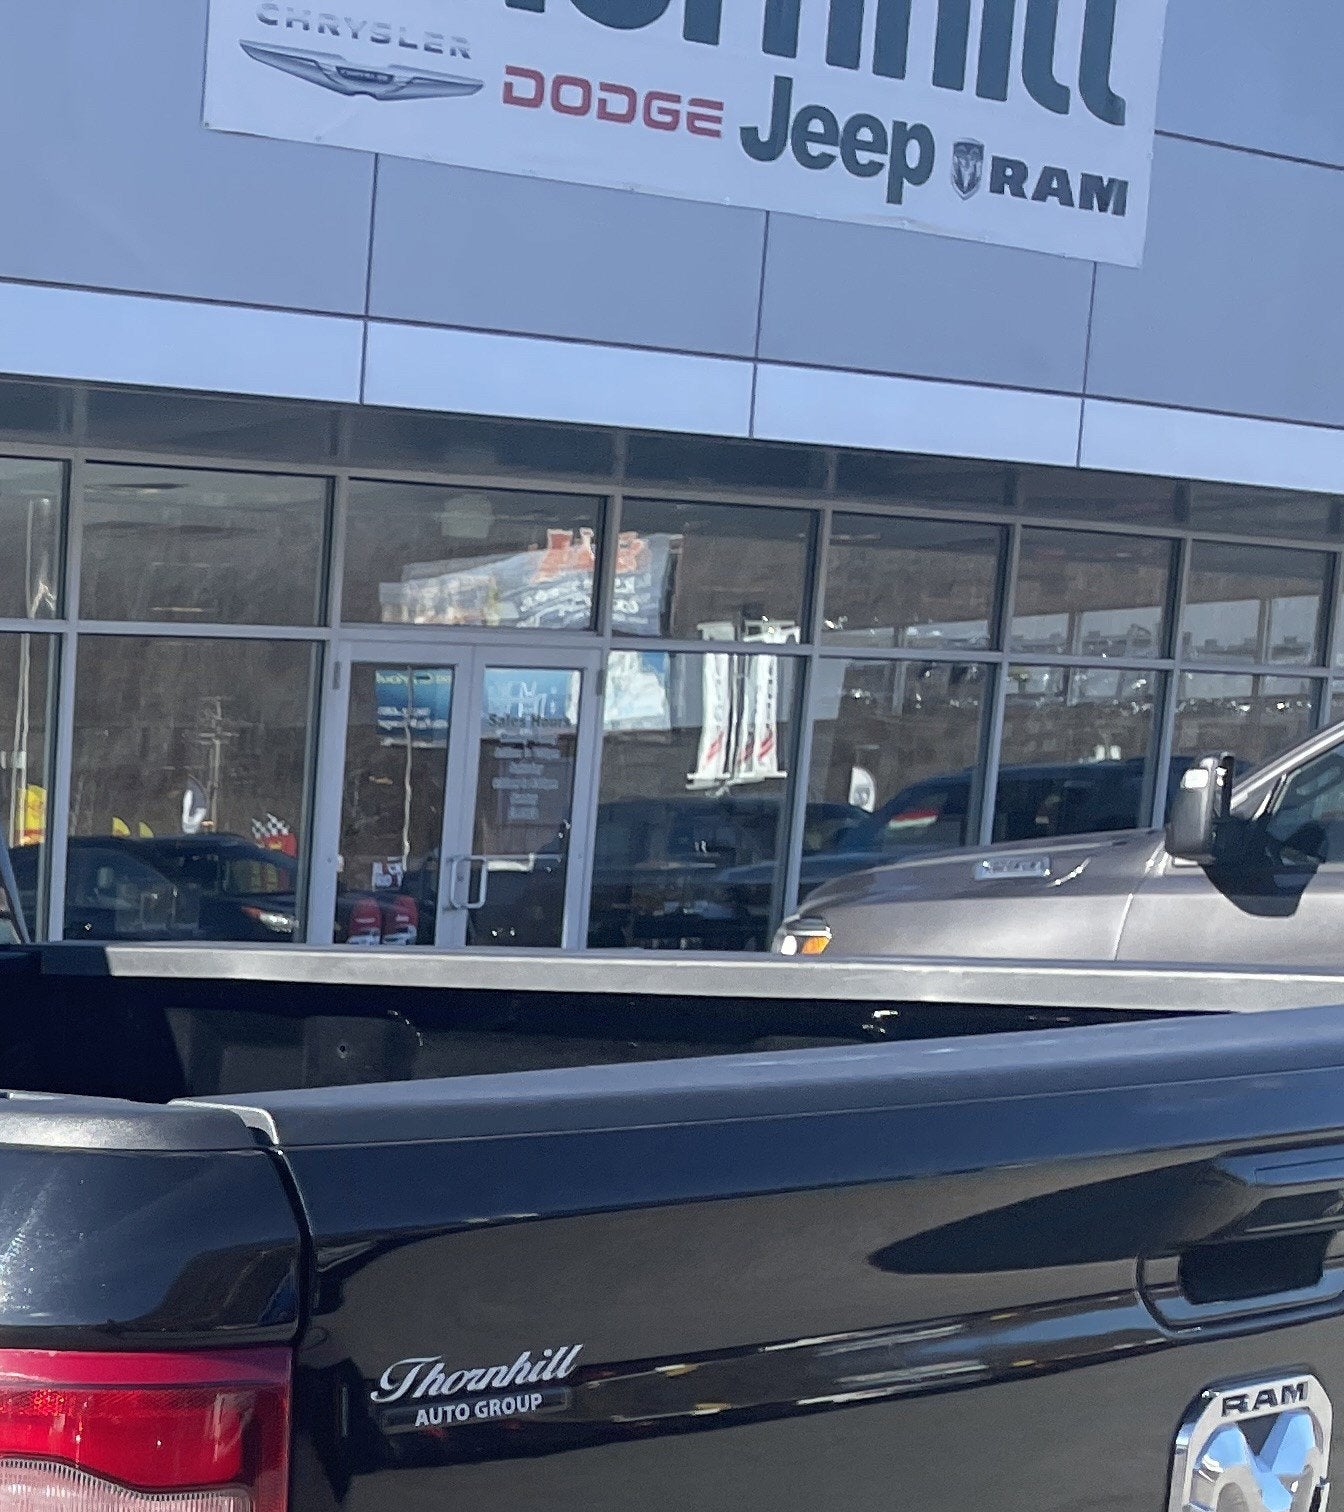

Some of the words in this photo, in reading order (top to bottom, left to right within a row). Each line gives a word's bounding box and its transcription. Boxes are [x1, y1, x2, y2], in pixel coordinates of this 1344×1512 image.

[256, 2, 472, 60] CHRYSLER
[502, 64, 725, 139] DODGE
[739, 75, 935, 204] Jeep
[988, 155, 1129, 217] RAM
[370, 1344, 584, 1403] Thornhill
[1220, 1381, 1309, 1417] RAM
[415, 1403, 470, 1427] AUTO
[474, 1393, 543, 1418] GROUP
